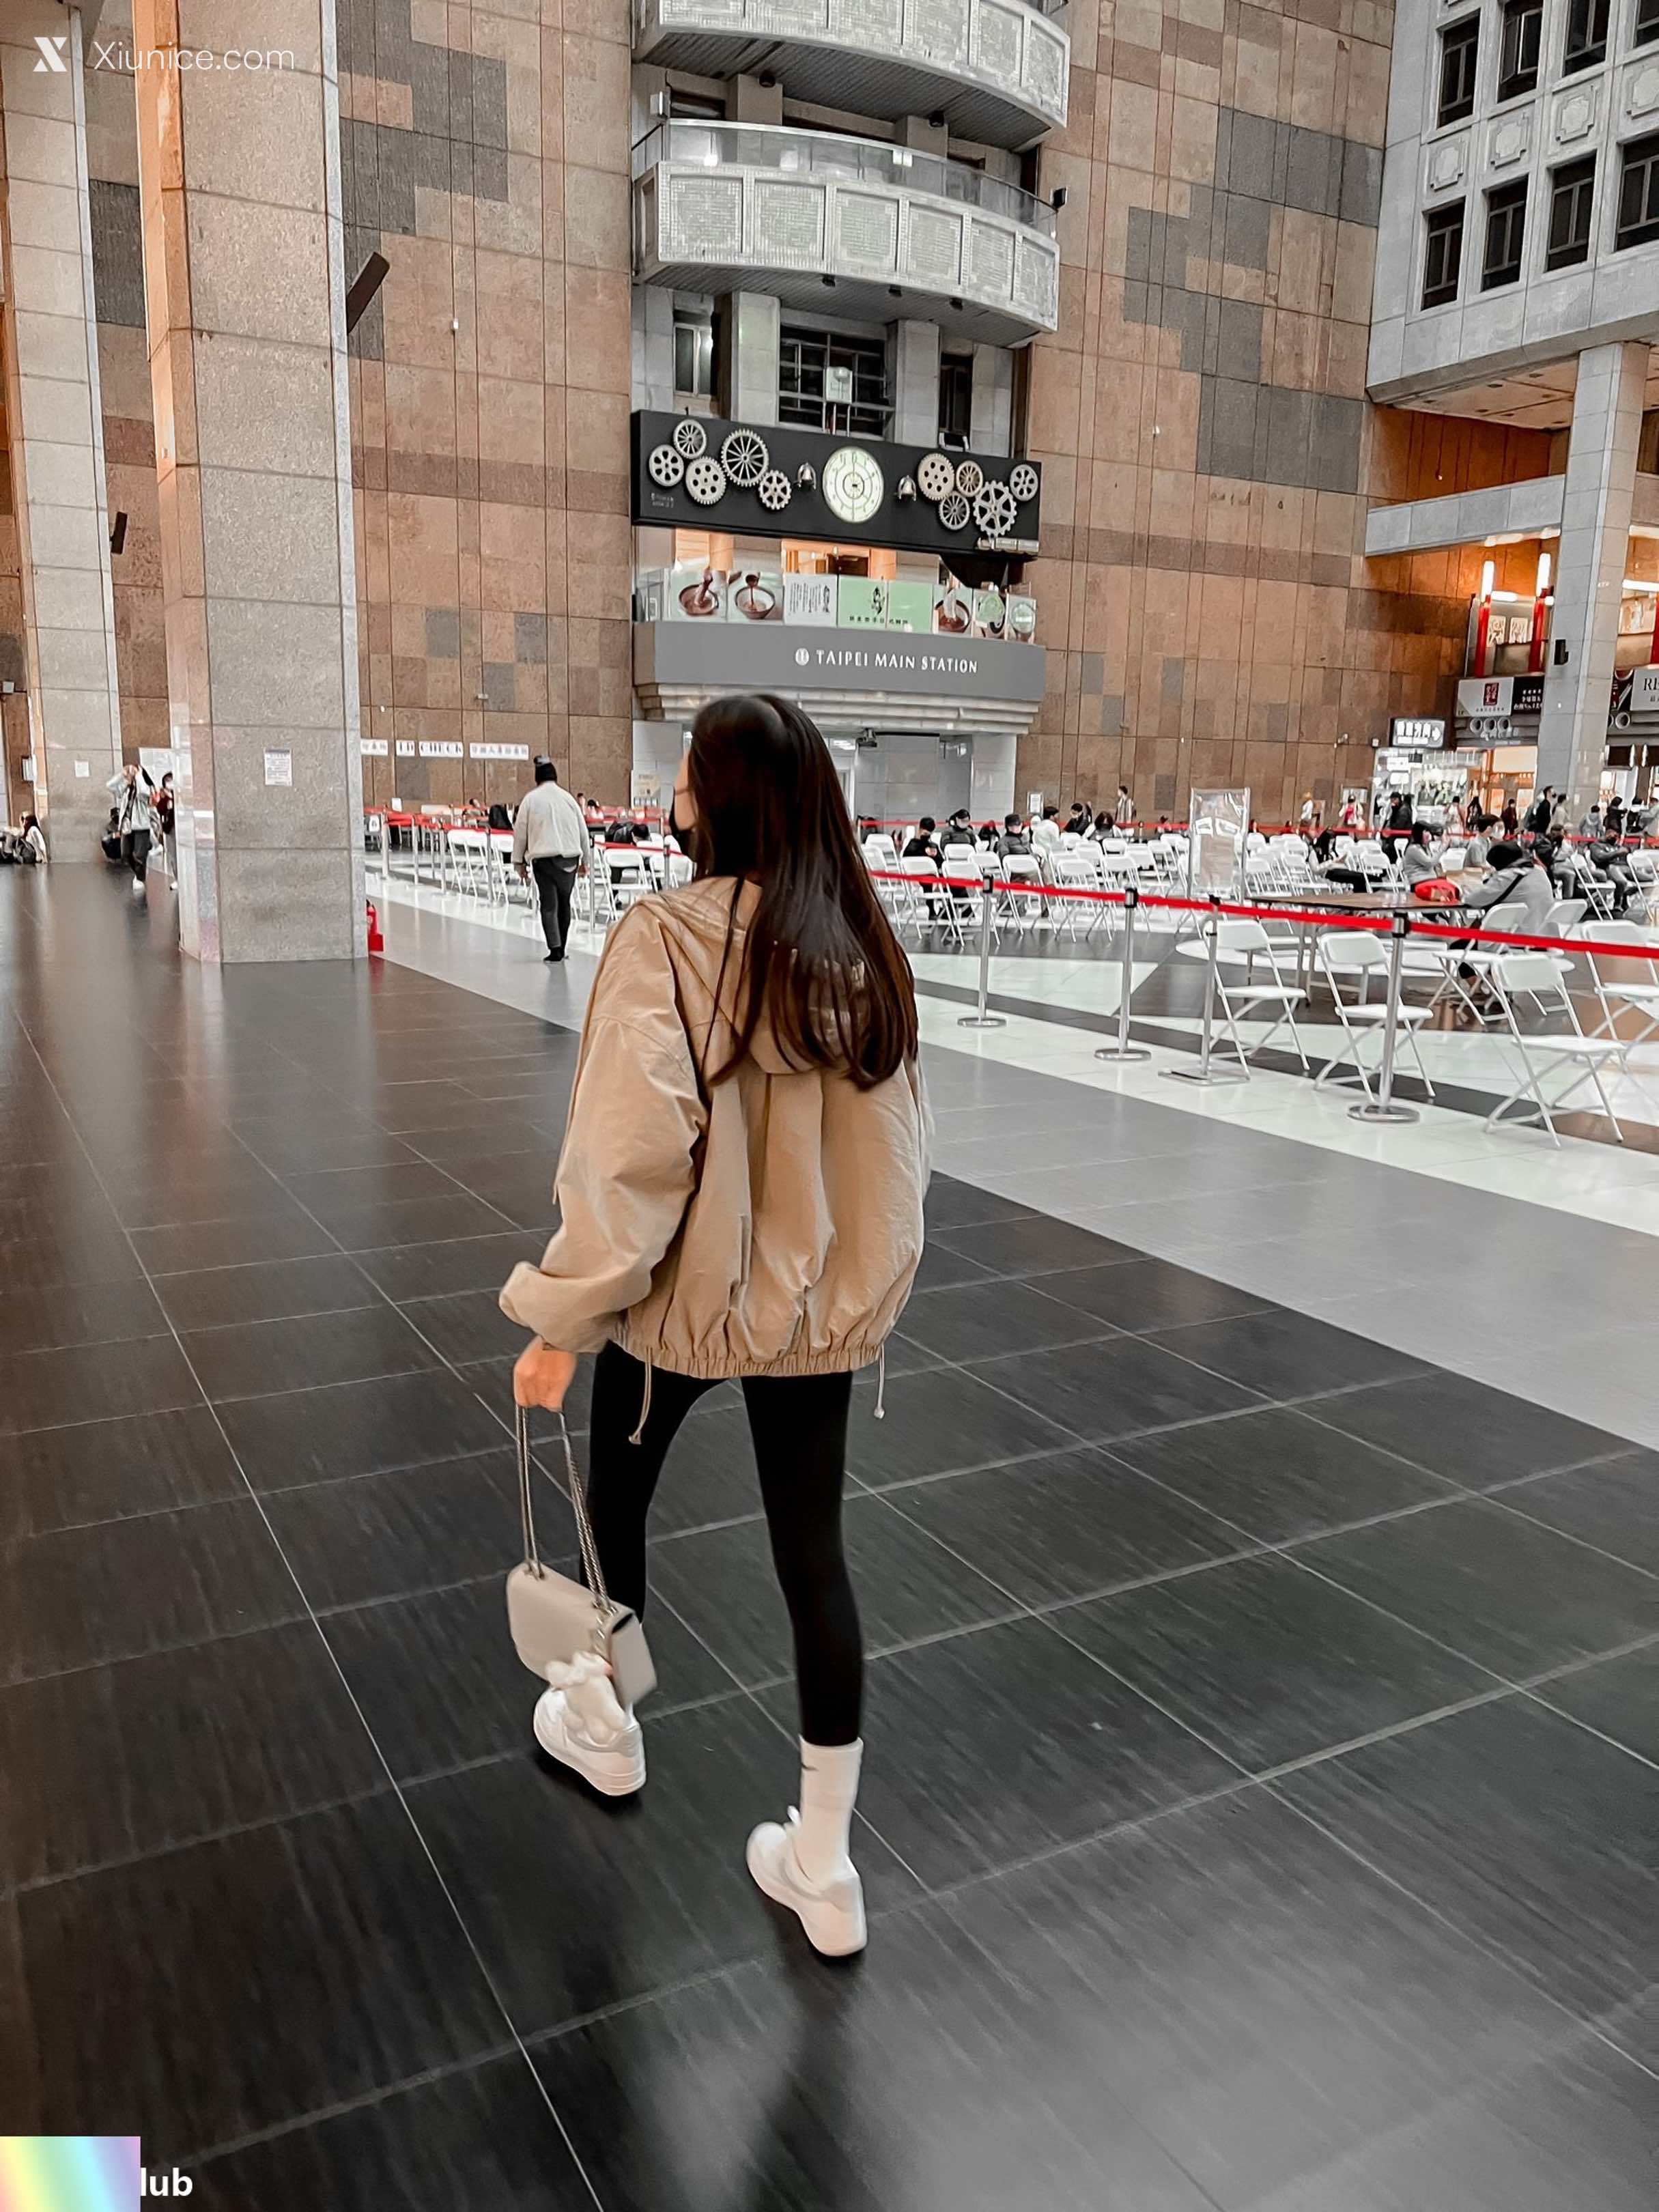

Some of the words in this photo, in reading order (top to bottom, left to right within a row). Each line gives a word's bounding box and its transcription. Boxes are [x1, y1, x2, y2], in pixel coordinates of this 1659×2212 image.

[816, 649, 868, 666] TAIPEI
[875, 653, 915, 669] MAIN
[921, 656, 978, 673] STATION
